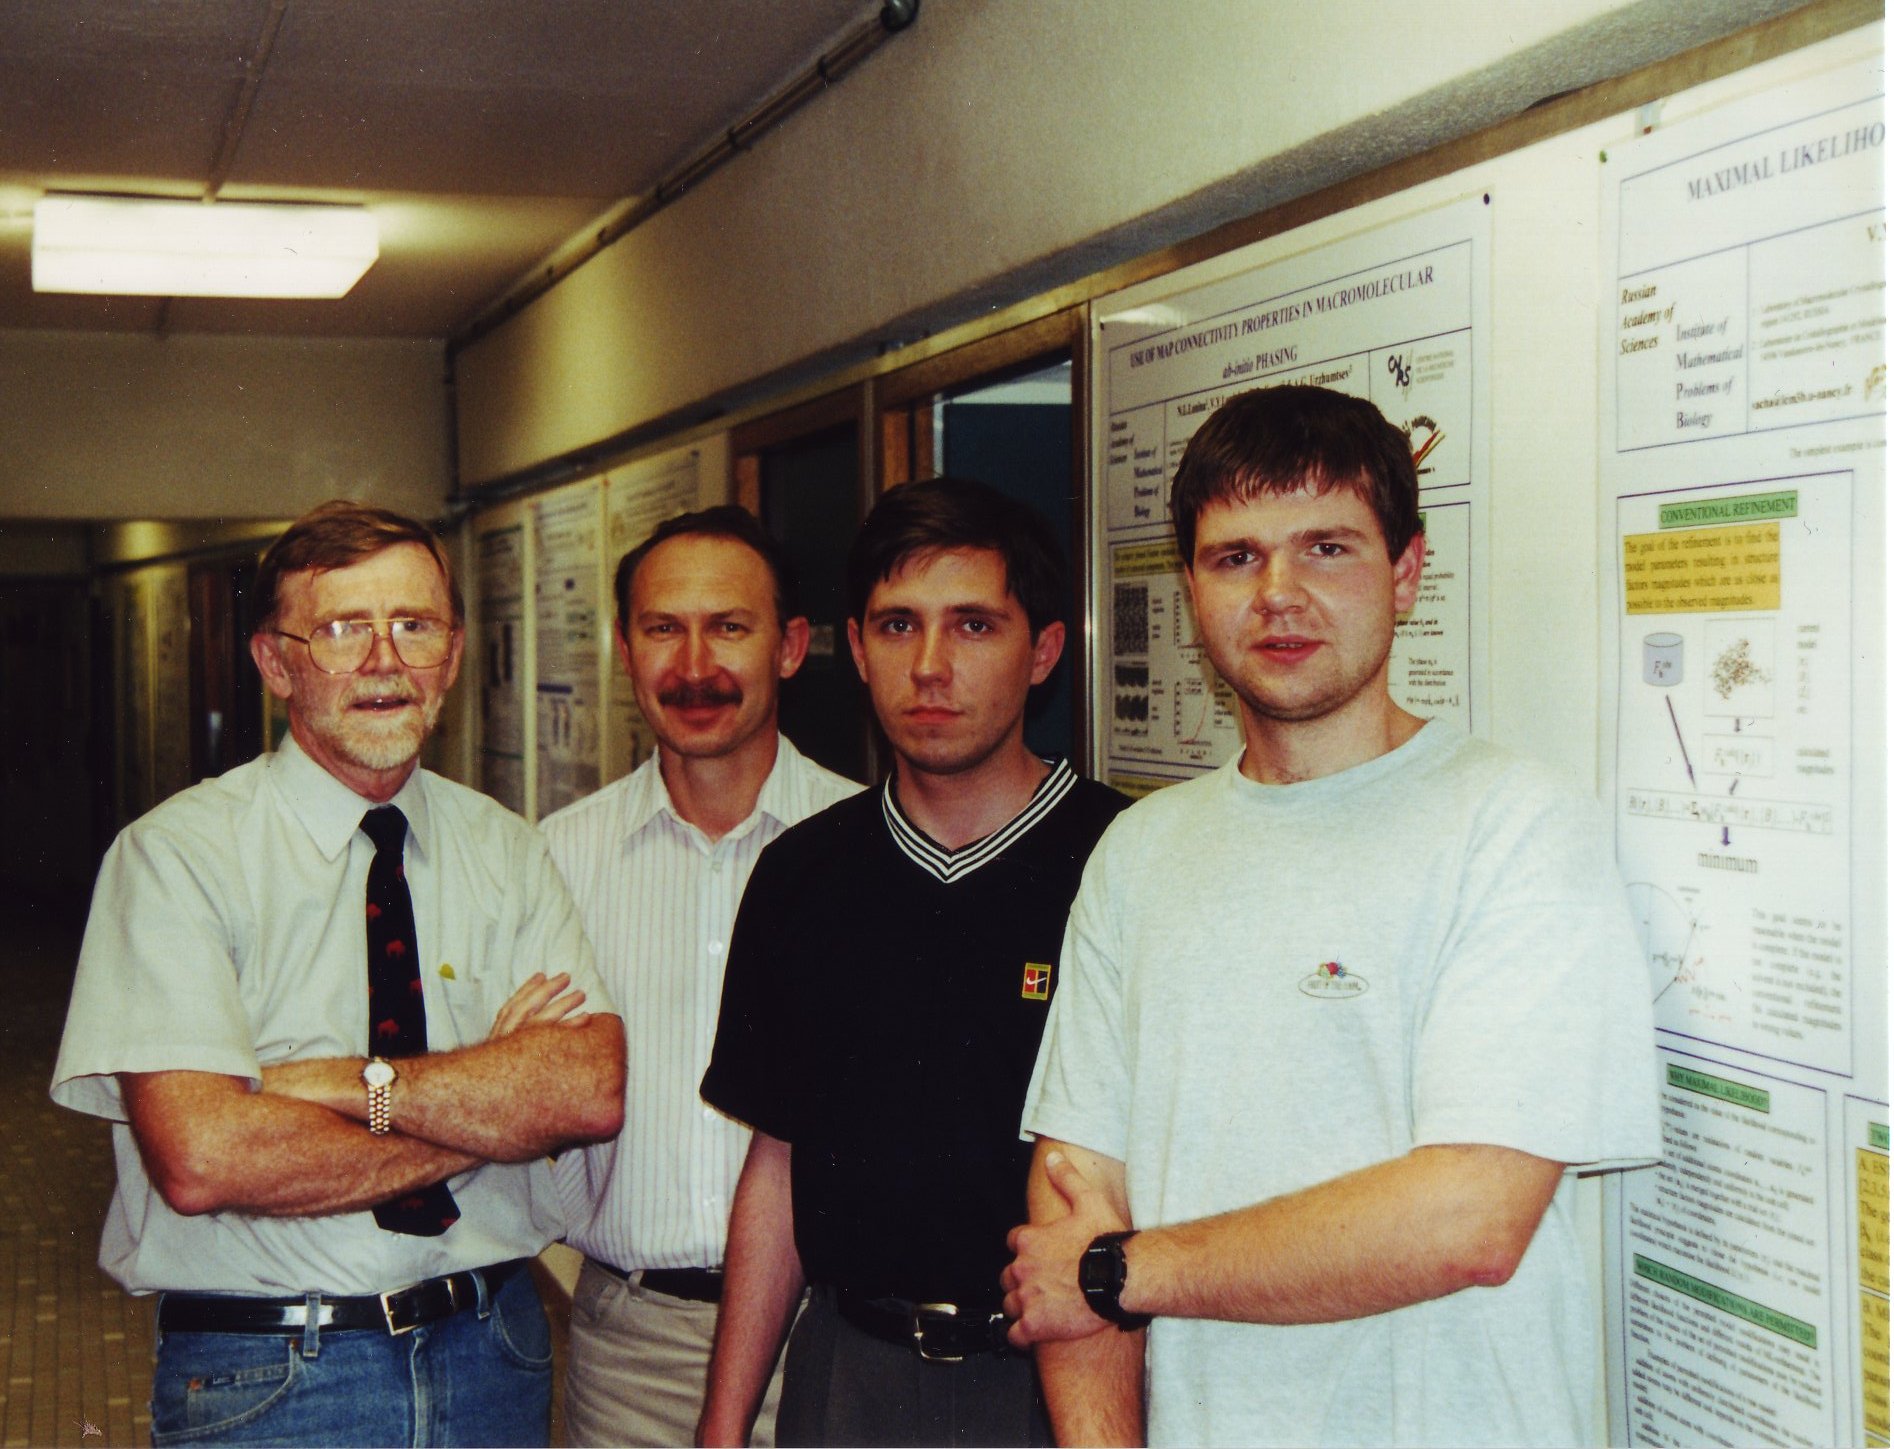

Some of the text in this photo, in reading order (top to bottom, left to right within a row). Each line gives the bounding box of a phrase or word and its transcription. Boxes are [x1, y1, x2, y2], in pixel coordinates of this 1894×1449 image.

[1687, 121, 1886, 200] MAXIMAL LIKELIHO
[1620, 285, 1657, 305] Russian
[1156, 341, 1174, 360] MAP
[1174, 322, 1239, 356] CONNECTIVITY
[1241, 303, 1300, 336] PROPERTIES
[1302, 301, 1313, 319] IN
[1315, 265, 1434, 315] MACROMOLECULAR
[1621, 301, 1677, 331] Academy of
[1676, 316, 1730, 341] Institute of
[1256, 345, 1298, 371] PHASING
[1619, 336, 1659, 356] Sciences
[1675, 344, 1744, 370] Mathematical
[1676, 375, 1735, 400] Problems of
[1676, 411, 1713, 430] Biology
[1660, 497, 1797, 524] CONVENTIONAL REFINEMENT
[1681, 535, 1721, 549] refinement
[1698, 852, 1758, 875] minimum
